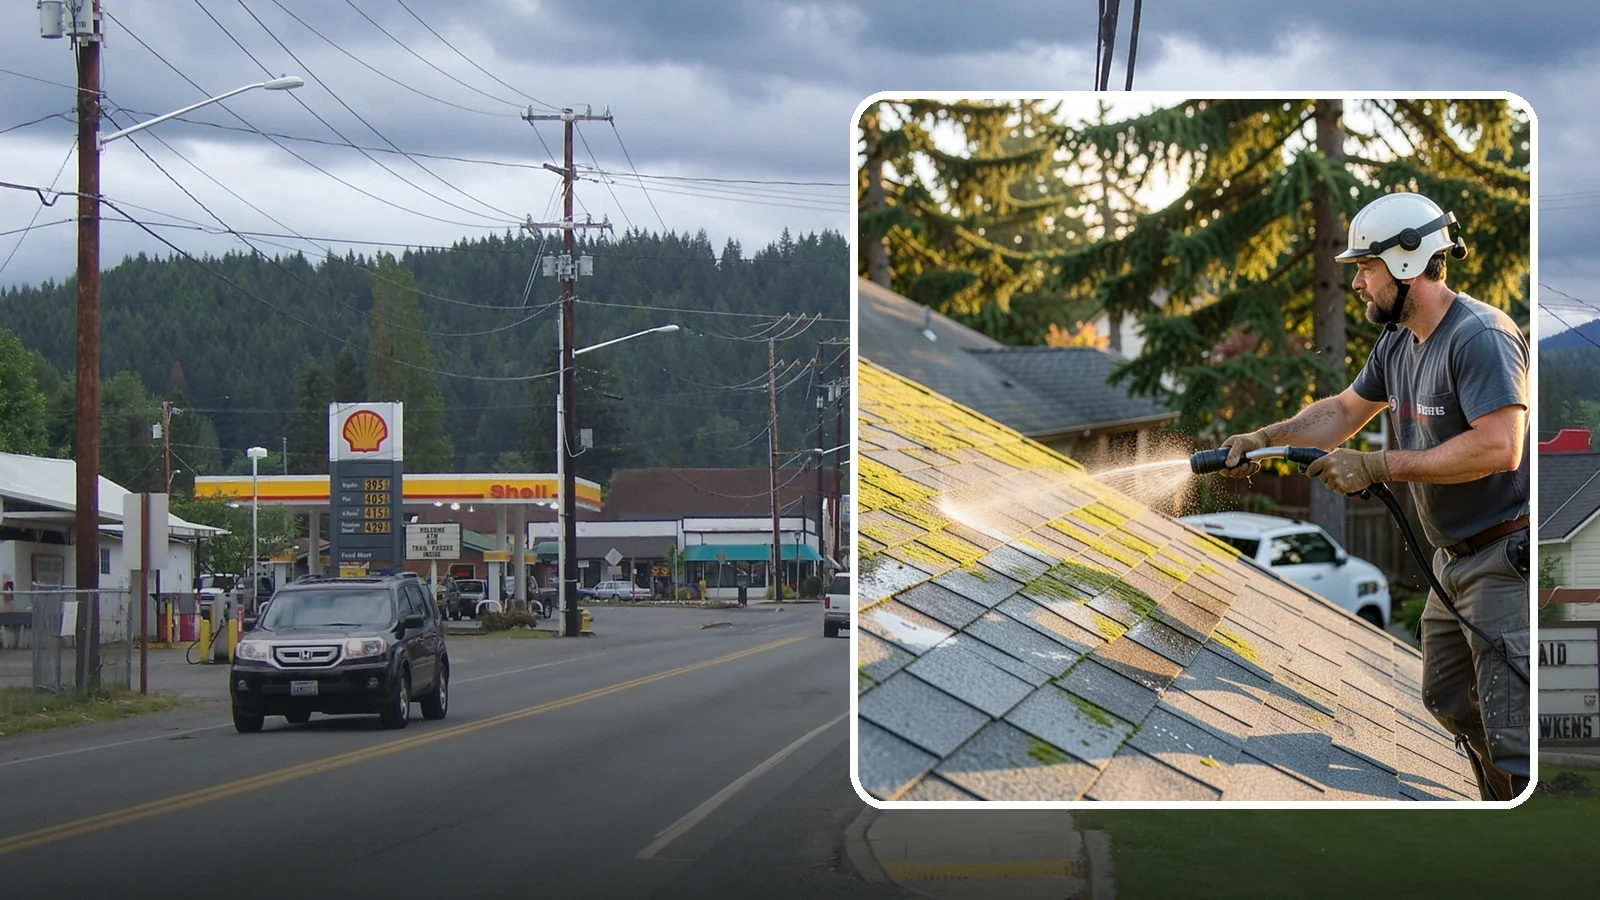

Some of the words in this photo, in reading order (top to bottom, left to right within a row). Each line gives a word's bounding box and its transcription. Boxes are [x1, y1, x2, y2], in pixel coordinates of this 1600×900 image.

[366, 480, 383, 490] 395
[490, 484, 547, 499] Shell
[366, 494, 383, 504] 405
[366, 508, 383, 518] 415
[366, 522, 383, 533] 429
[1538, 642, 1567, 666] AID
